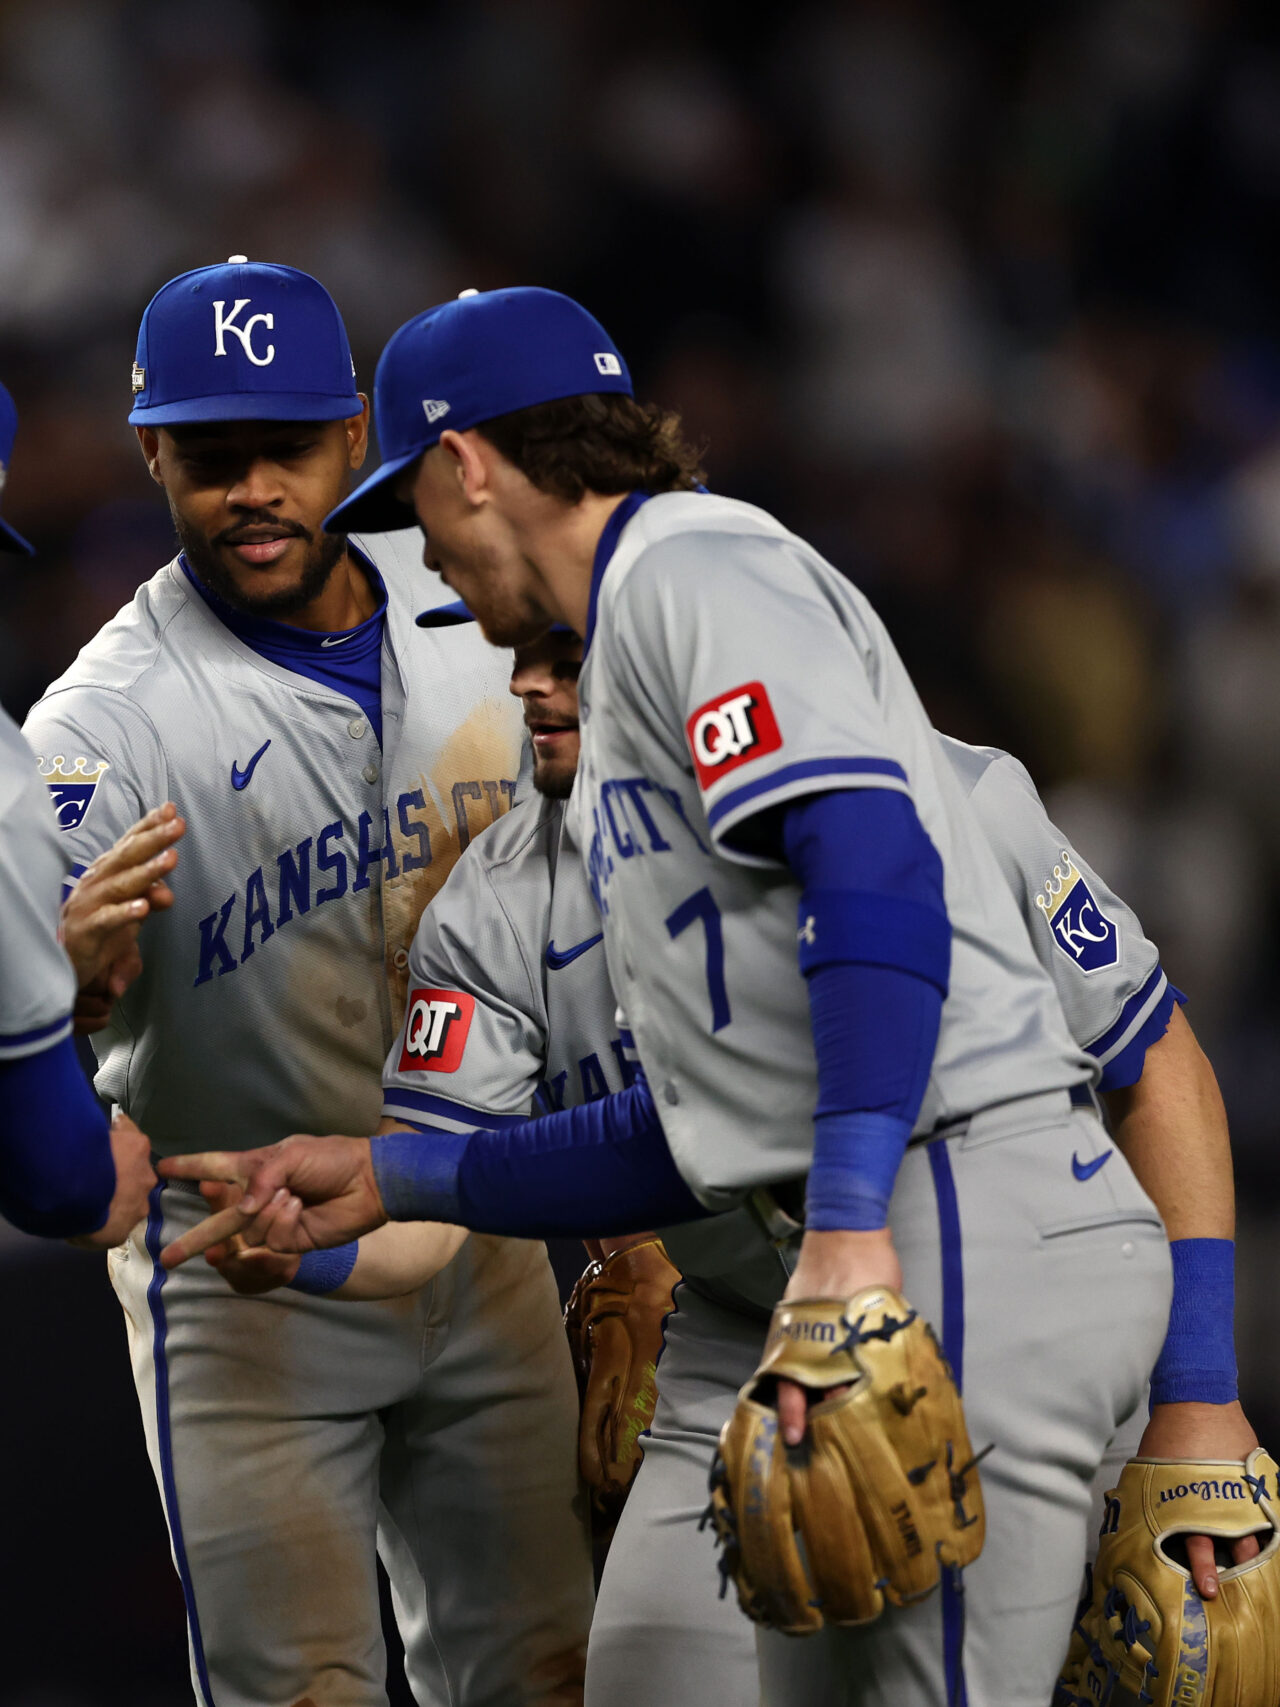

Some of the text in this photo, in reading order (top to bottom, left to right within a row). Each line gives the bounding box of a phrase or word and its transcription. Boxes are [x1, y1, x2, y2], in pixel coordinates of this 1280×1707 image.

[212, 299, 275, 366] KC
[693, 693, 757, 767] QT
[49, 791, 85, 827] C
[194, 788, 433, 987] KANSAS
[664, 886, 732, 1034] 7
[1055, 898, 1109, 959] KC
[406, 999, 460, 1059] QT
[1160, 1479, 1246, 1503] Wilson
